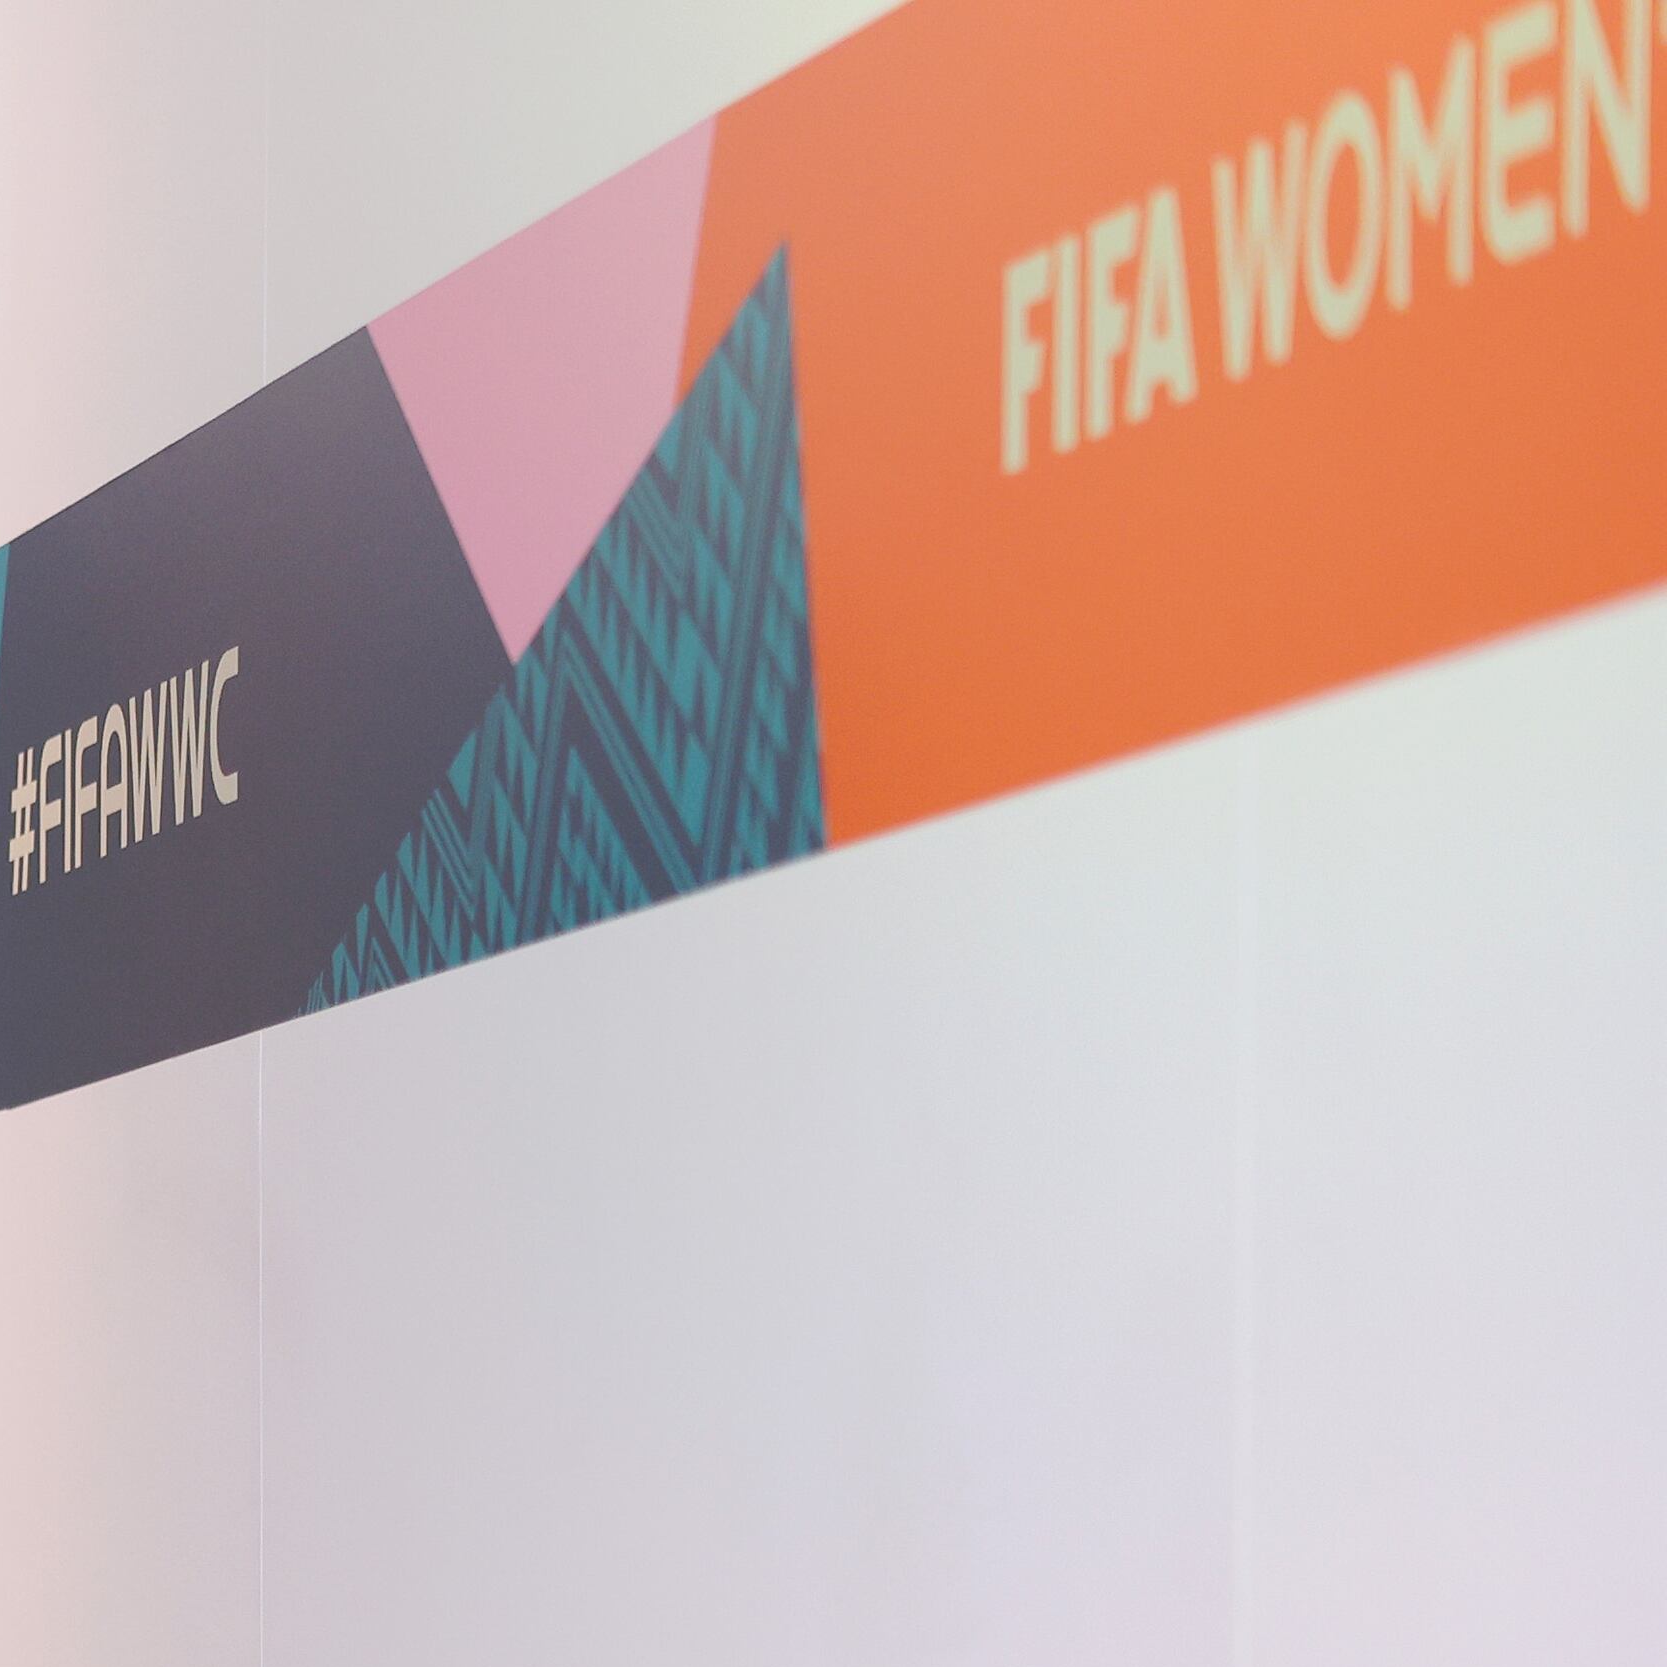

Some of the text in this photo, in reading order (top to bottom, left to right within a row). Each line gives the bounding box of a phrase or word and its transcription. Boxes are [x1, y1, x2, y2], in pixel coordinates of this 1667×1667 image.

[1001, 0, 1667, 476] FIFA WOMEN
[9, 645, 239, 896] #FIFAWWC
